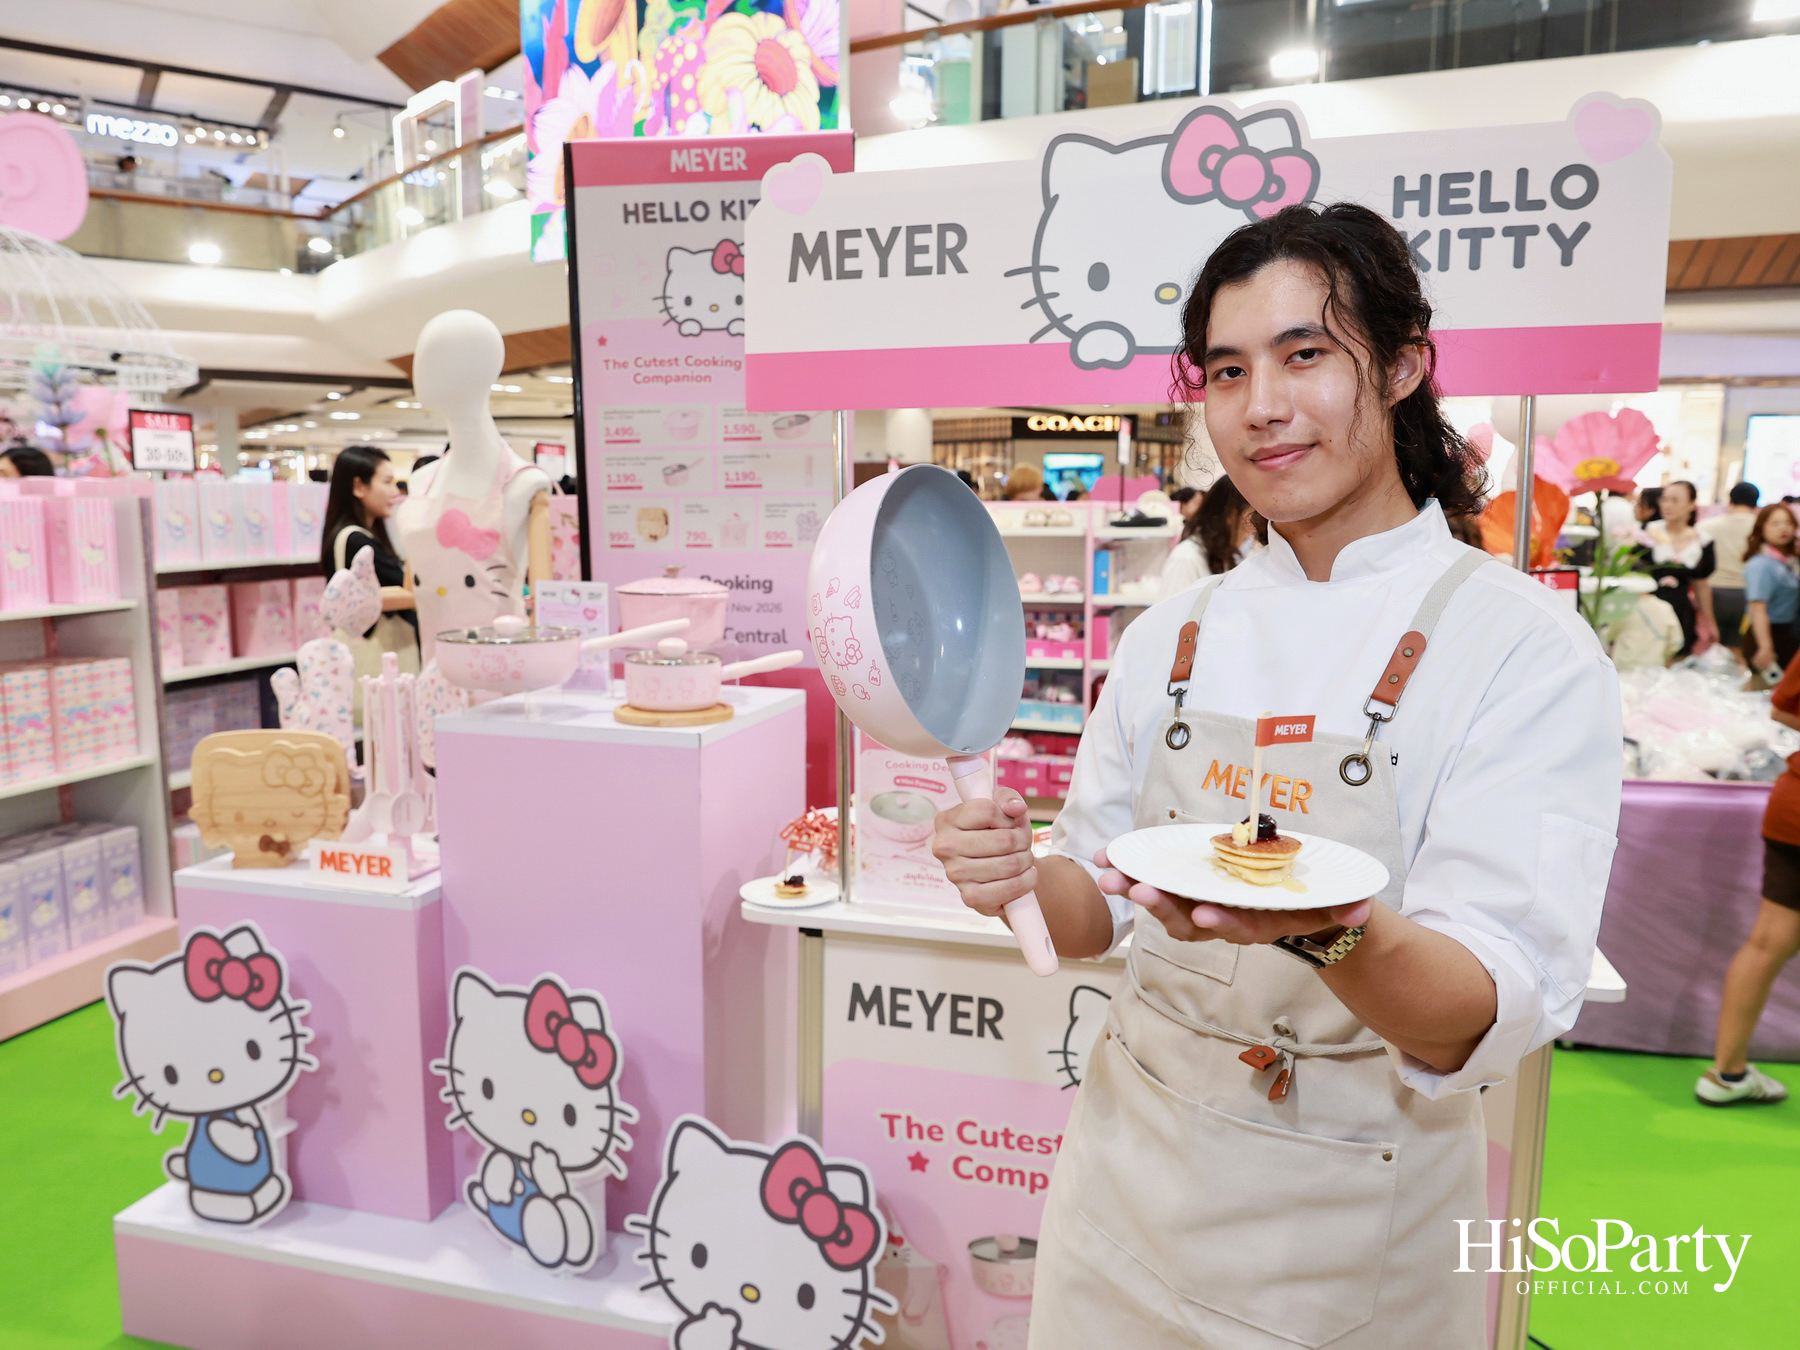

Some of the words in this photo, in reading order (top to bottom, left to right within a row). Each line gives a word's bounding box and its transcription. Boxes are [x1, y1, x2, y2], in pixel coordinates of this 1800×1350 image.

[87, 113, 178, 147] mezzo
[670, 147, 747, 172] MEYER
[1392, 163, 1600, 218] HELLO
[623, 200, 709, 223] HELLO
[788, 223, 968, 283] MEYER
[1400, 221, 1592, 273] KITTY
[603, 359, 629, 370] The
[634, 356, 679, 368] Cutest
[684, 355, 742, 371] Cooking
[632, 372, 712, 385] Companion
[144, 412, 180, 430] SALE
[731, 603, 752, 613] Nov
[1274, 724, 1307, 736] MEYER
[885, 760, 929, 772] Cooking
[320, 850, 392, 878] MEYER
[848, 982, 1005, 1041] MEYER
[880, 1113, 944, 1142] The
